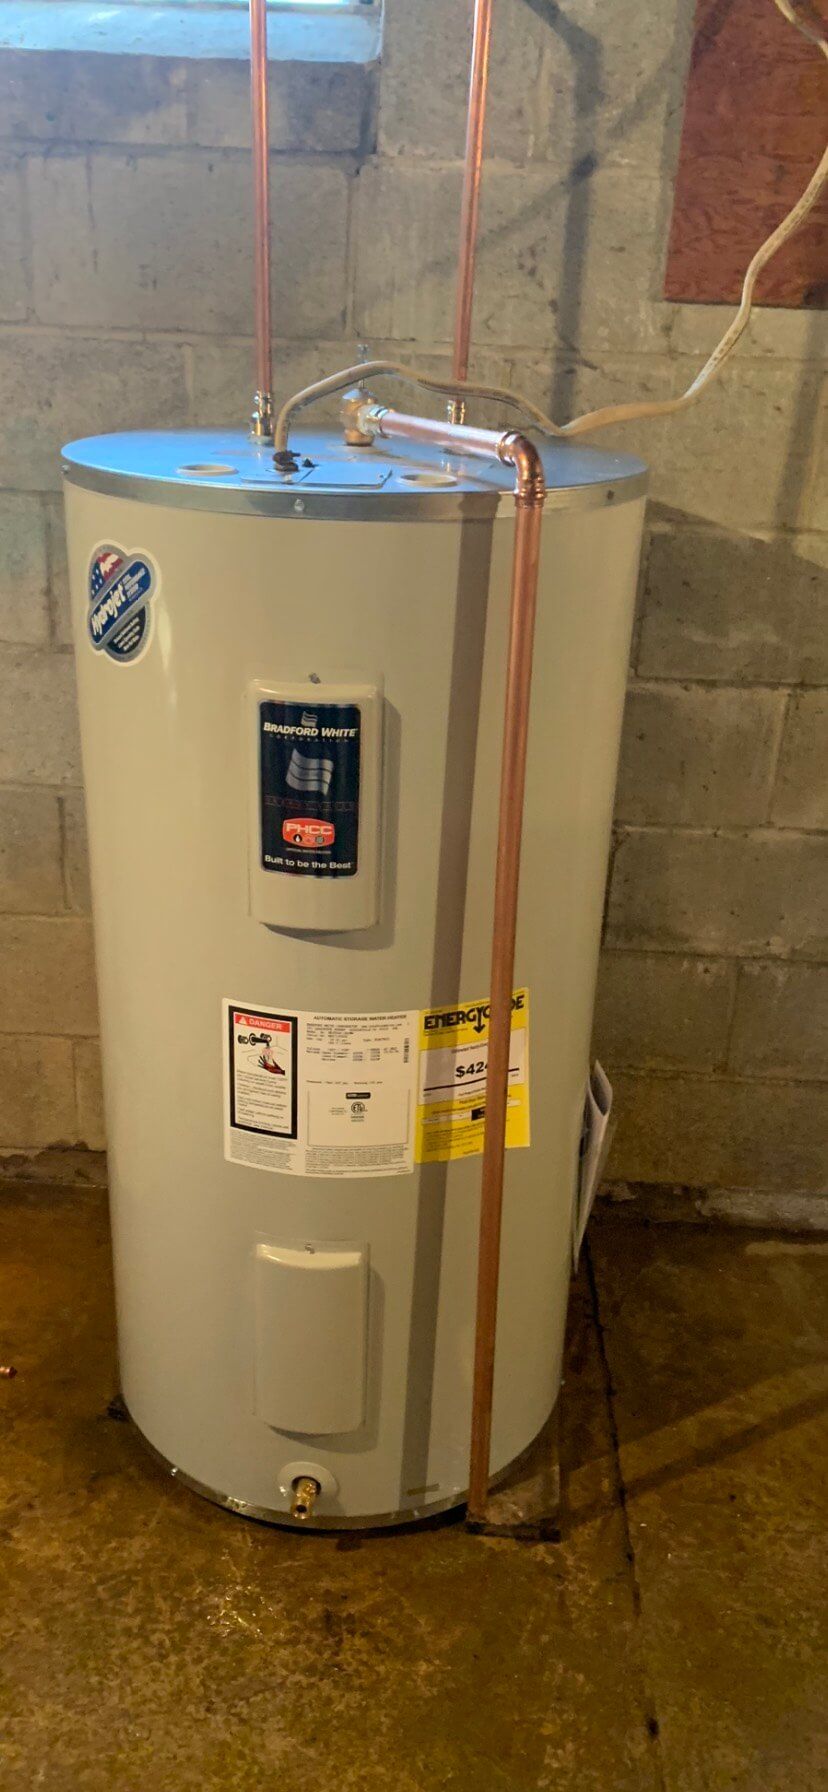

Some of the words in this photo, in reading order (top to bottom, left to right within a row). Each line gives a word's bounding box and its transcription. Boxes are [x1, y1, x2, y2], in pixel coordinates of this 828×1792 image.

[91, 583, 126, 636] Hydrojet
[263, 722, 319, 737] BRADFORD
[321, 727, 356, 738] WHITE
[285, 822, 332, 835] PHCC
[264, 854, 284, 865] Built
[297, 860, 310, 868] be
[312, 861, 327, 869] the
[329, 861, 352, 869] Best
[249, 1018, 283, 1030] DANGER
[455, 1061, 488, 1078] $42
